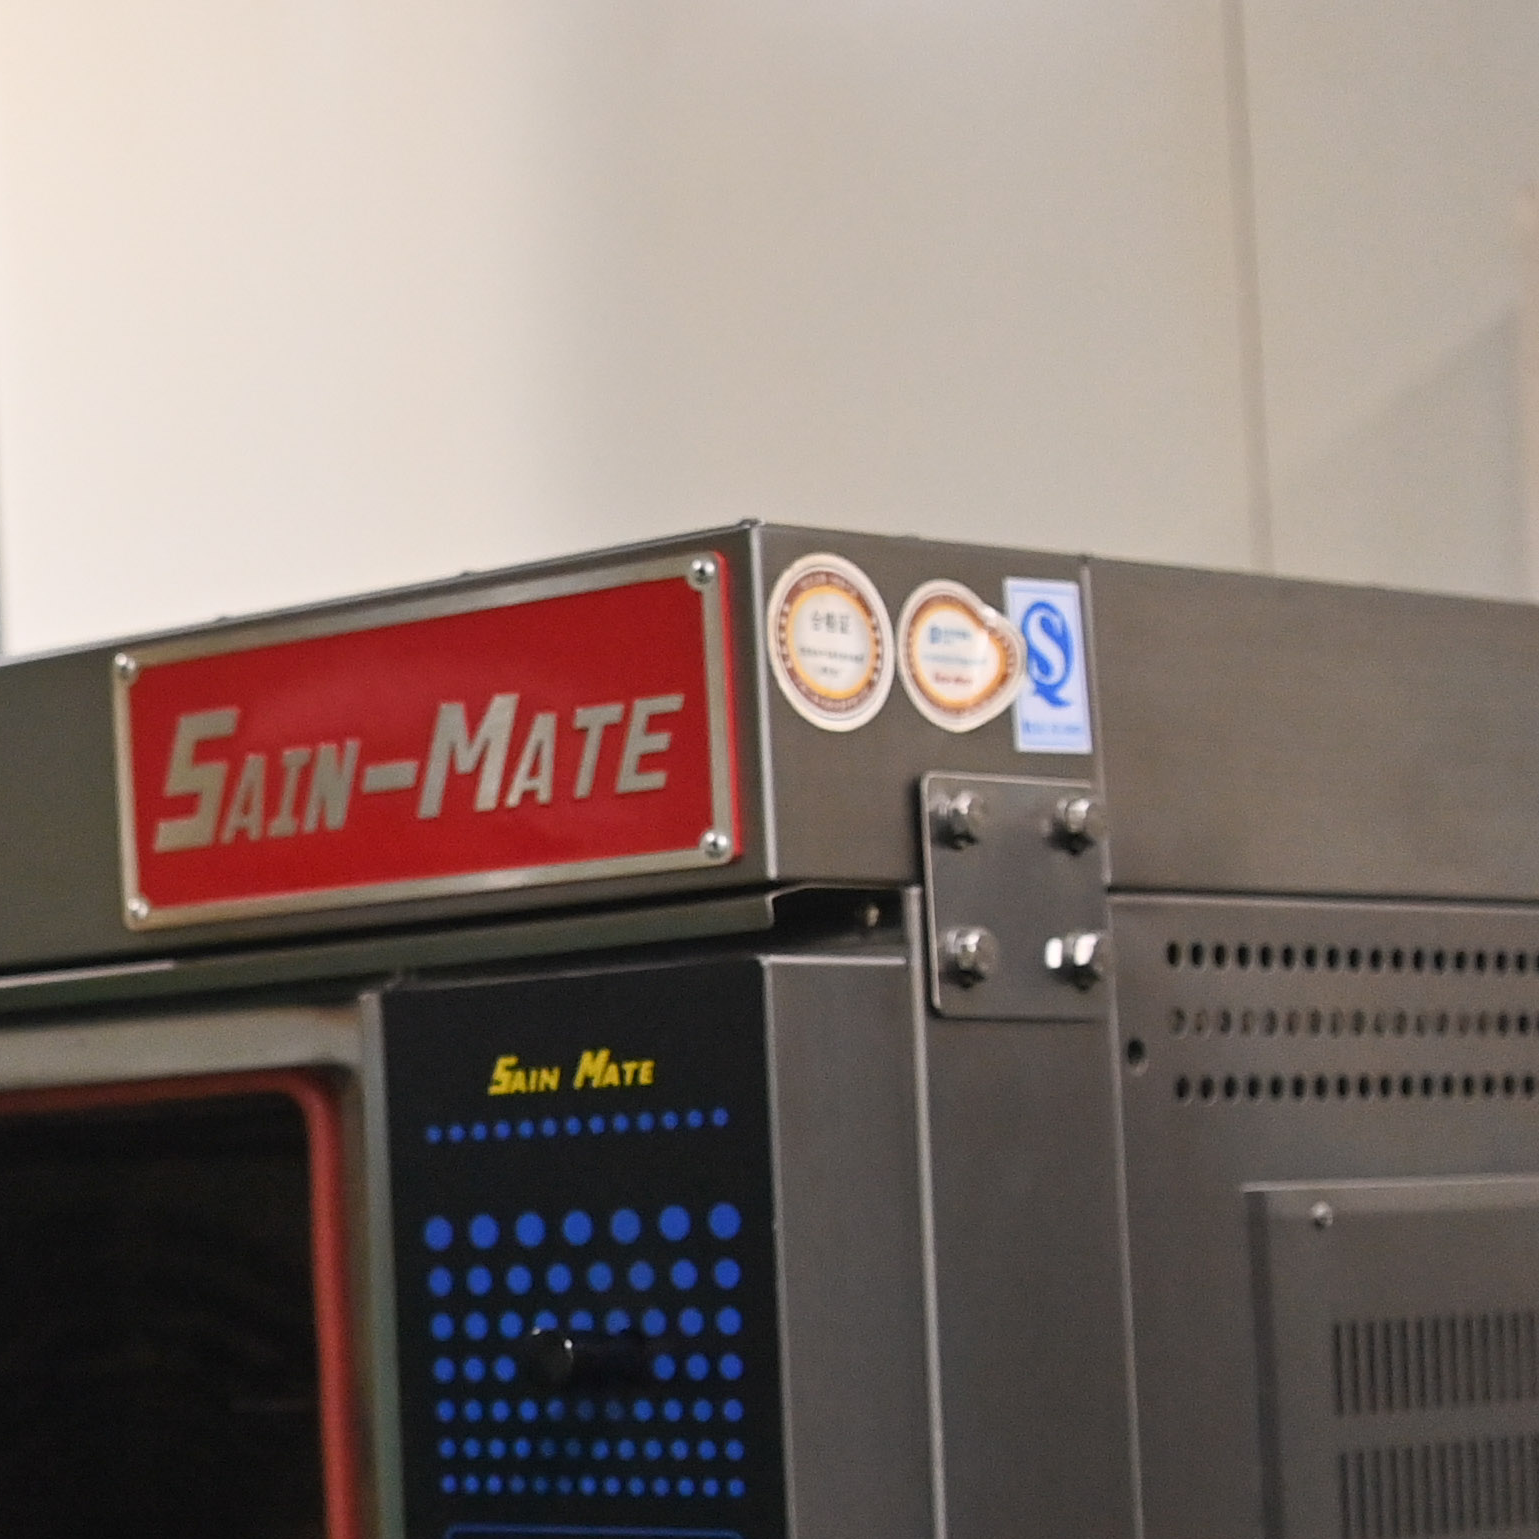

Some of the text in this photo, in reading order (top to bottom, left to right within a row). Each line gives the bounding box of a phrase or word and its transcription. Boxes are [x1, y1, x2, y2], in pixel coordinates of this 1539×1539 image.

[153, 694, 685, 853] SAIN-MATE
[487, 1048, 655, 1096] SAIN MATE
